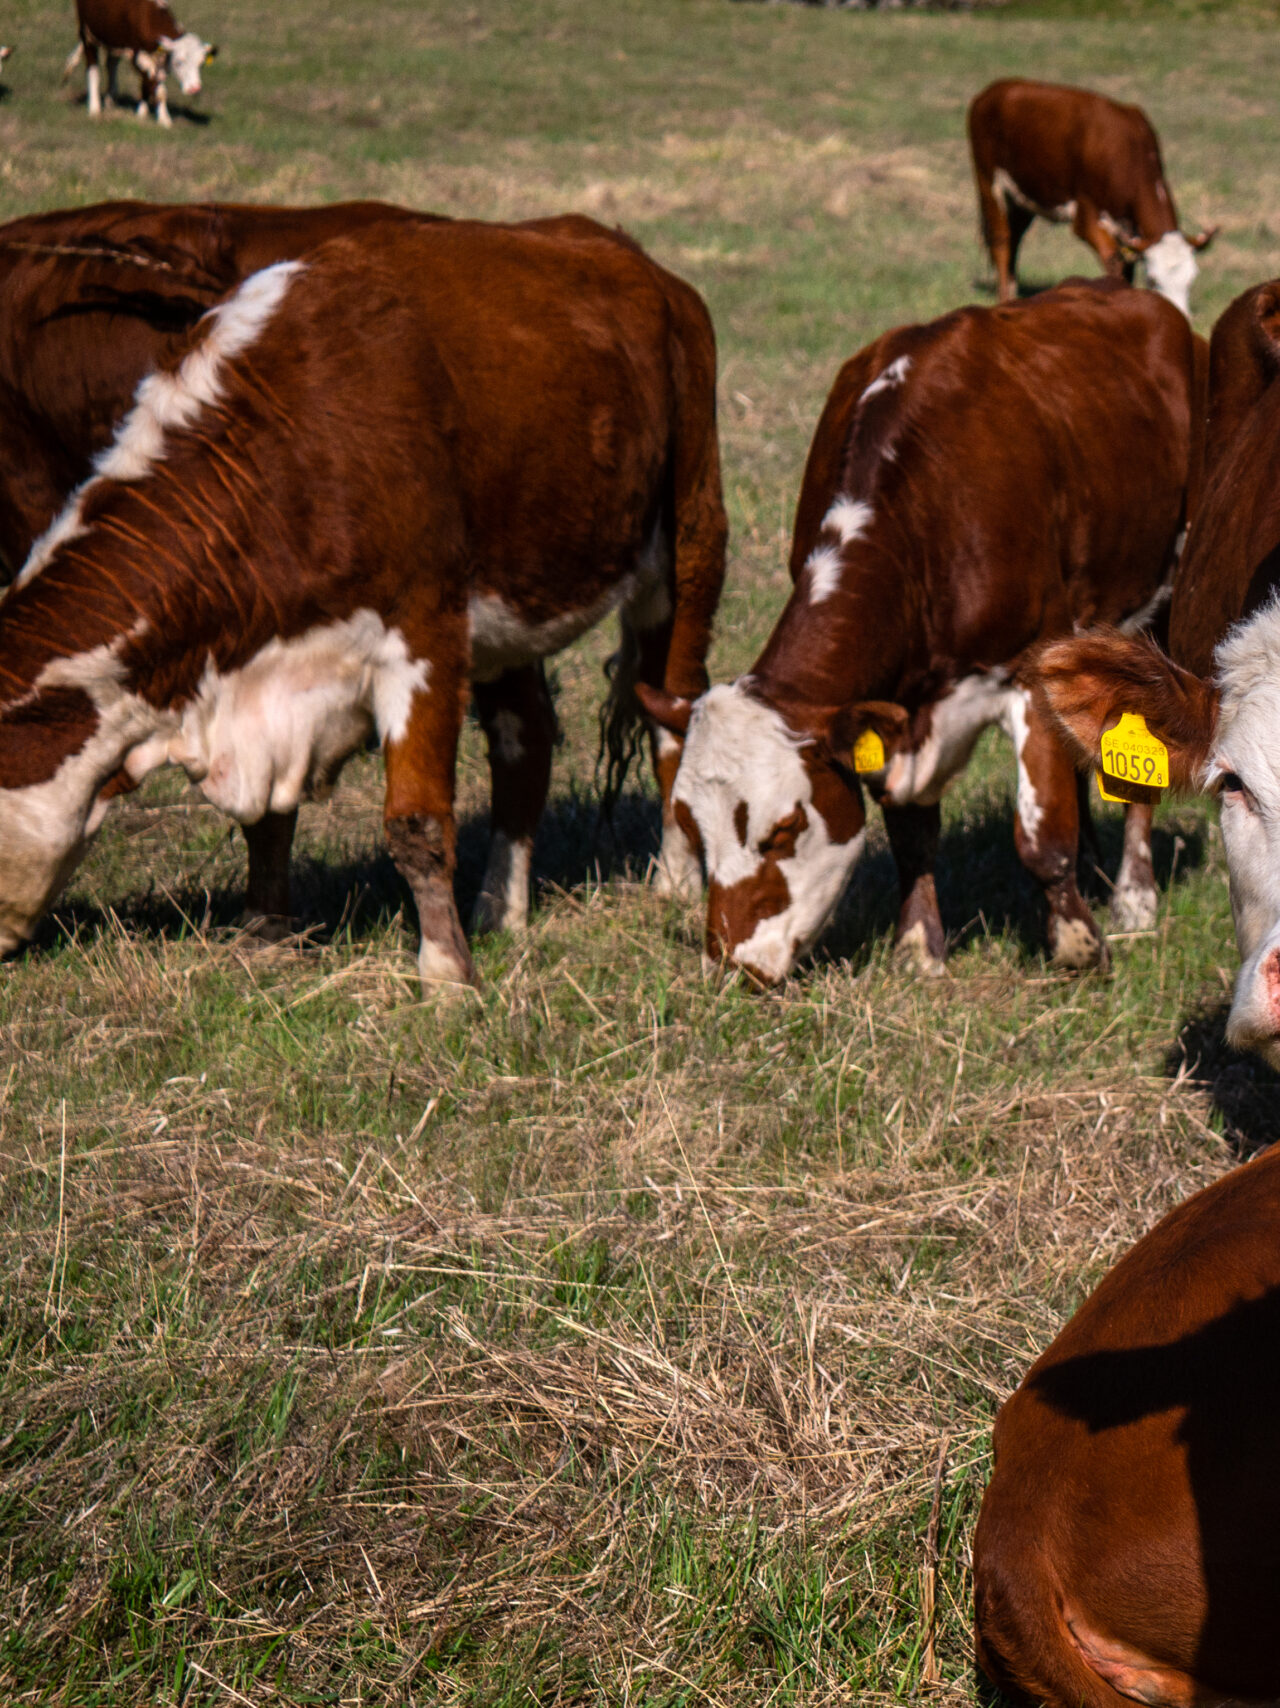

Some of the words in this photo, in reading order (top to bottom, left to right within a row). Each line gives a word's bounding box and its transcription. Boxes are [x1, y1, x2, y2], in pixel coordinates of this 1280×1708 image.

[1104, 737, 1119, 748] SE
[1123, 742, 1165, 756] 040323
[1105, 749, 1156, 783] 1059
